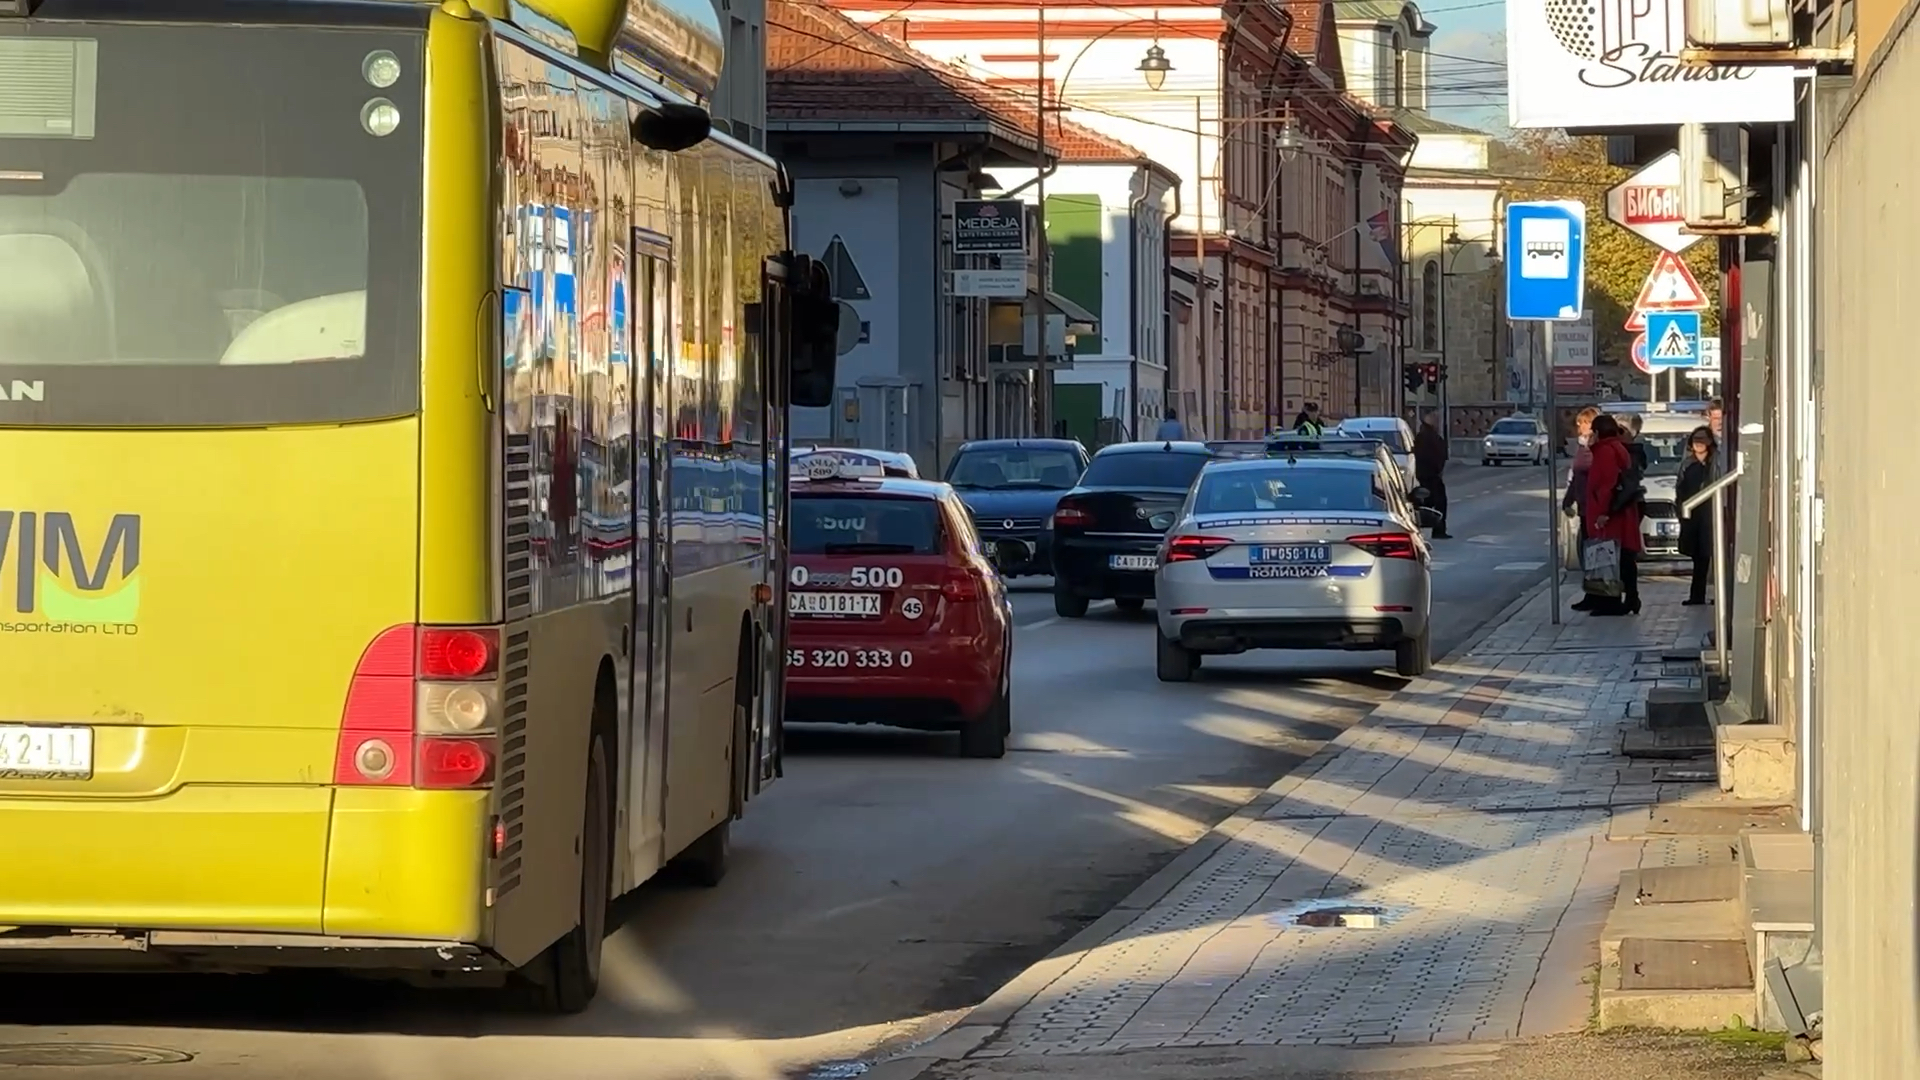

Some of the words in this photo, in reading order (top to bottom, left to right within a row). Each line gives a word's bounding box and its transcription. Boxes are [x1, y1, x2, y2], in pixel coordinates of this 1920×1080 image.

[958, 217, 1019, 229] MEDEJA
[851, 567, 904, 588] 500
[904, 603, 921, 614] 45
[103, 623, 139, 635] LTD
[811, 650, 849, 667] 320
[855, 650, 893, 667] 333
[900, 651, 913, 667] 0
